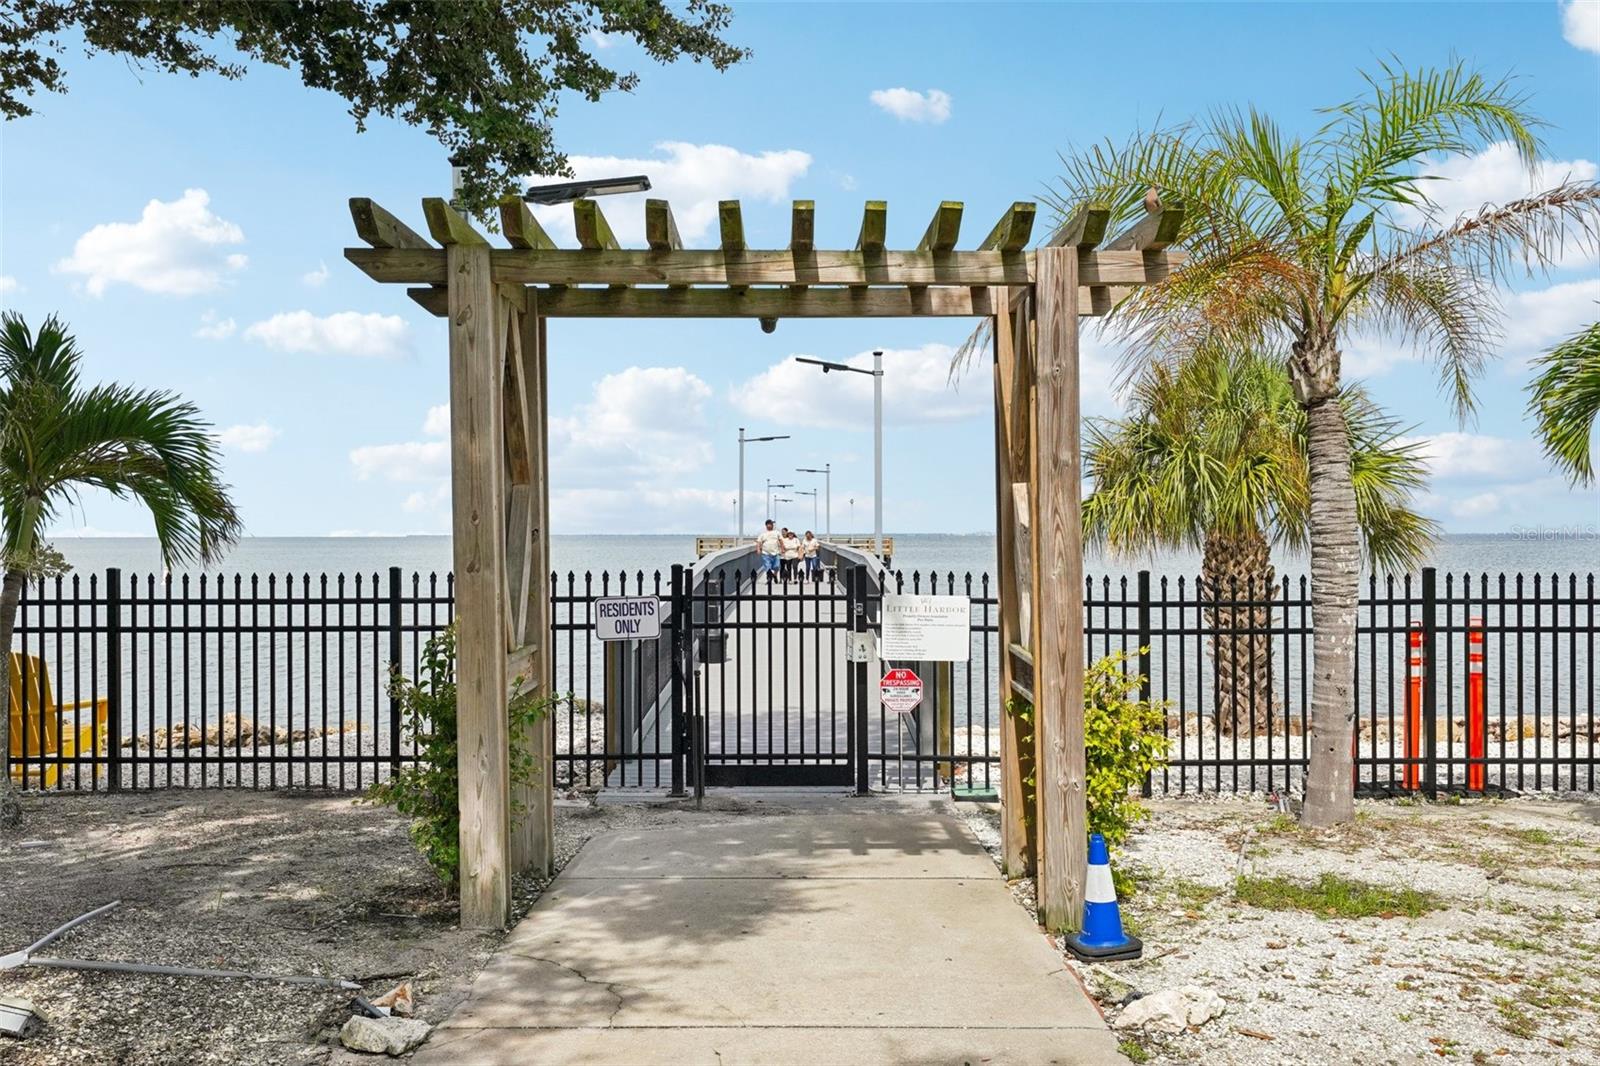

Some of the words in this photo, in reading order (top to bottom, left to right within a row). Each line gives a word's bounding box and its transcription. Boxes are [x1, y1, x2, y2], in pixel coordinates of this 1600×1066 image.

[599, 601, 655, 617] RESIDENTS
[886, 604, 918, 613] LITTLE
[924, 604, 967, 613] HARBOR
[614, 619, 641, 634] ONLY
[895, 671, 907, 679] NO
